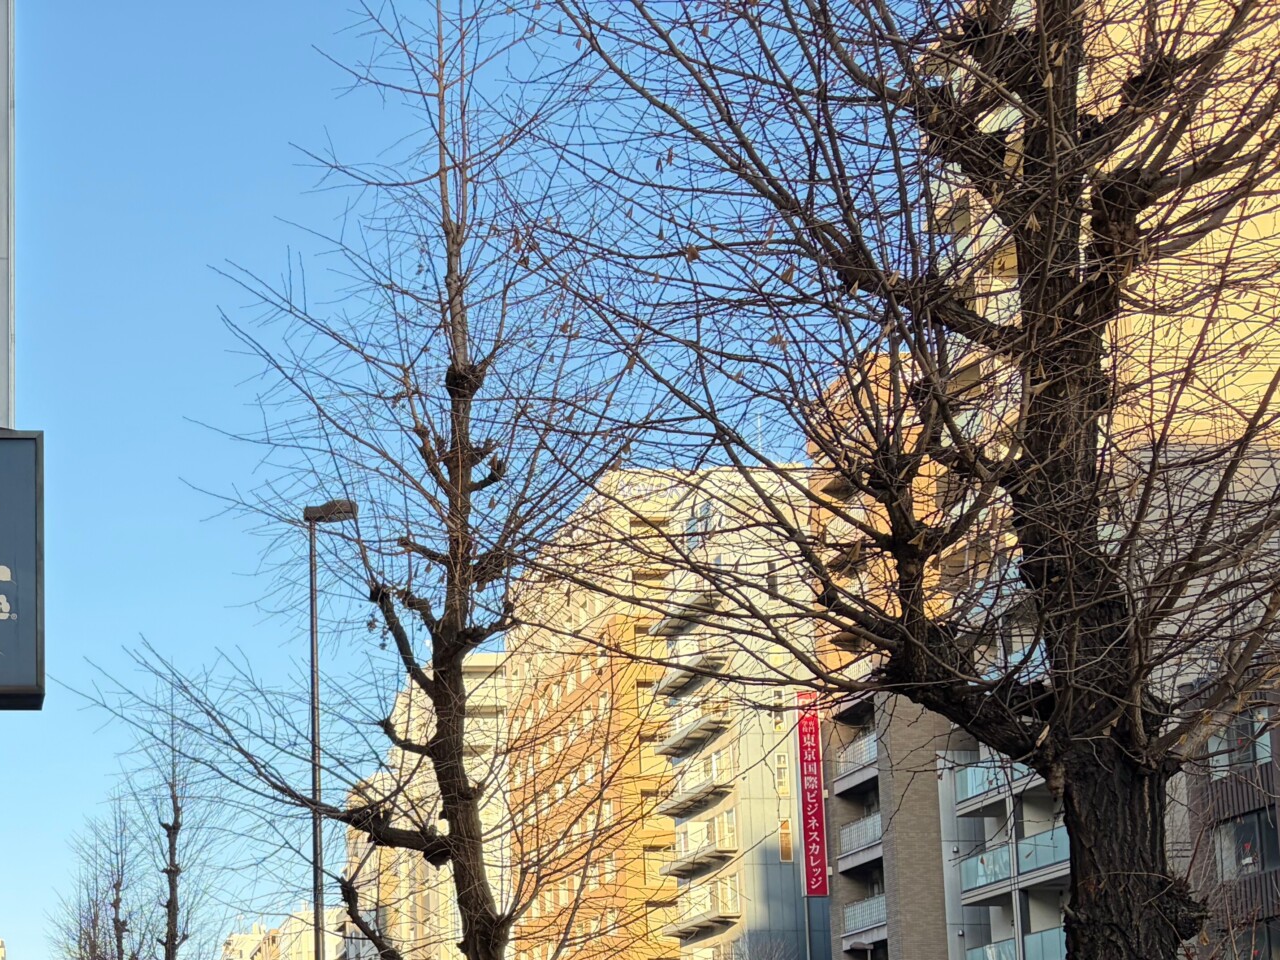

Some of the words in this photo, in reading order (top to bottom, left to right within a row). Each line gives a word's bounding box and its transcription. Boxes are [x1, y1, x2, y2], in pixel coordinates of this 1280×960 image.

[803, 733, 823, 890] 東京国際ビジネスカレッジ
